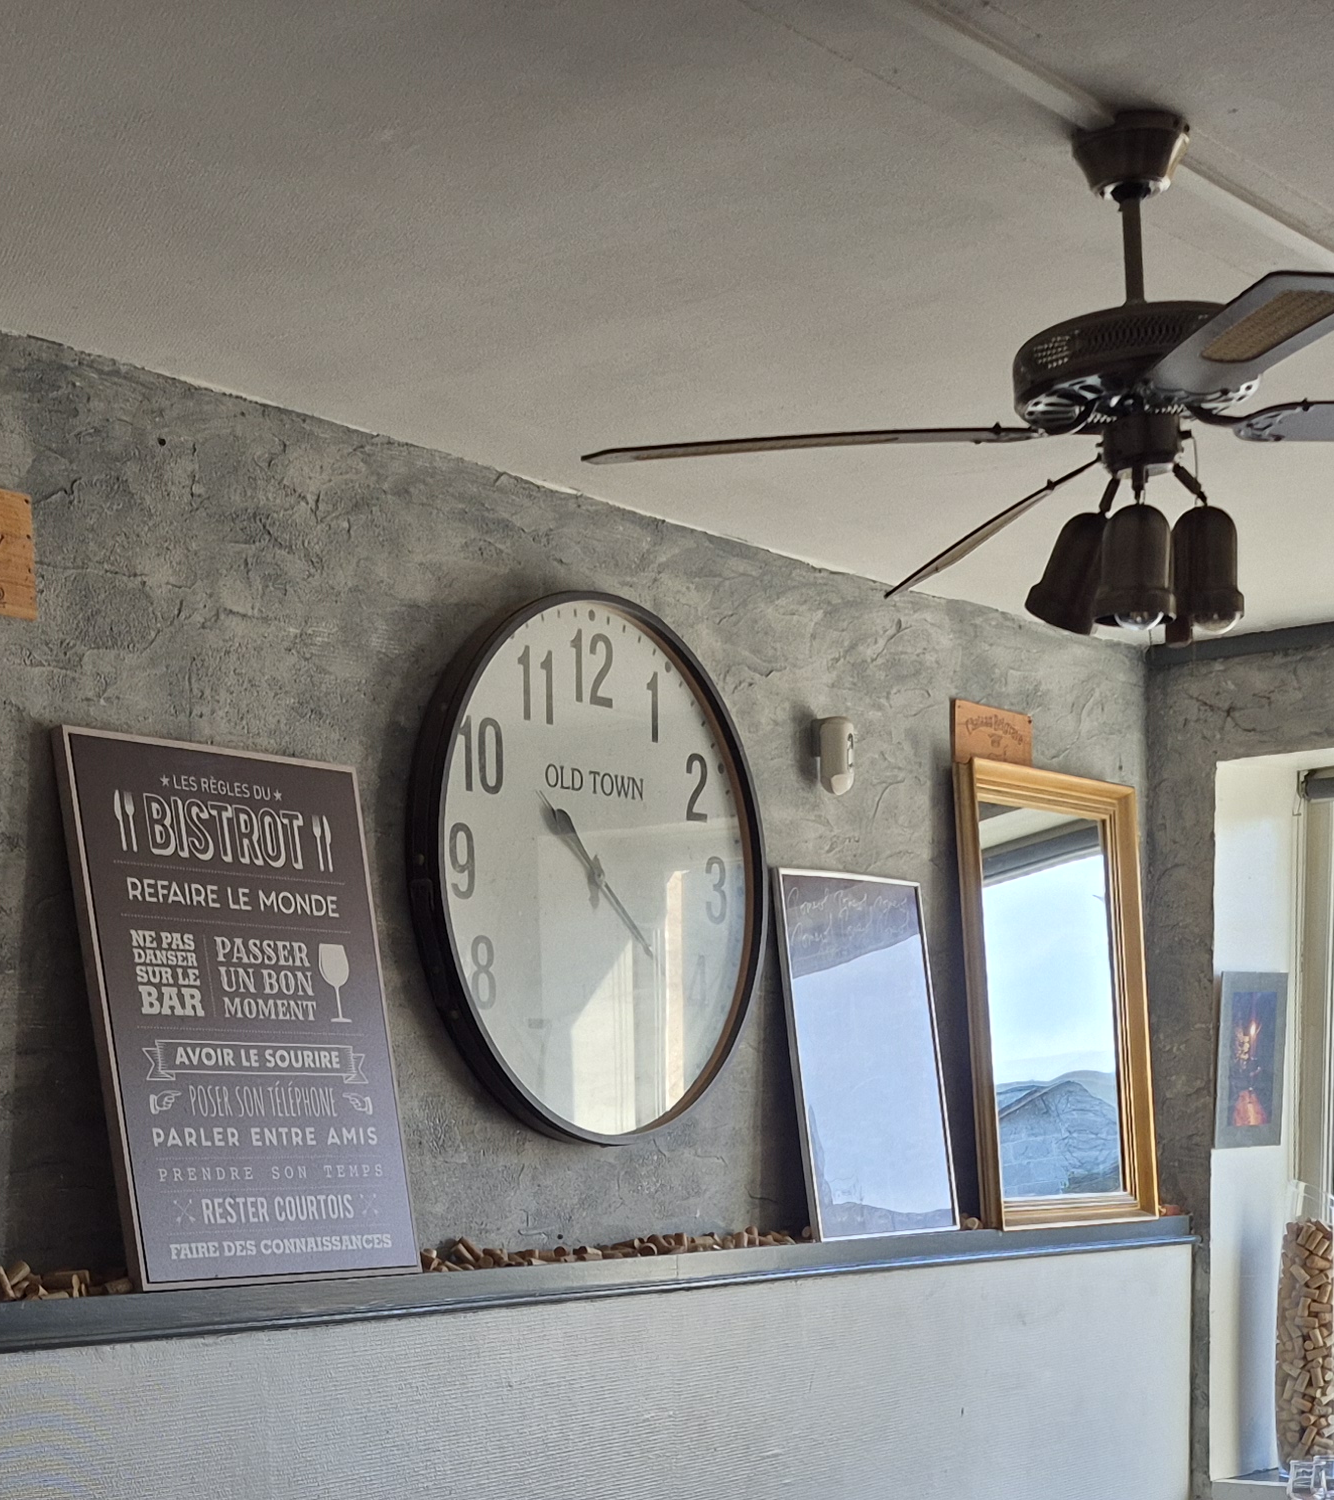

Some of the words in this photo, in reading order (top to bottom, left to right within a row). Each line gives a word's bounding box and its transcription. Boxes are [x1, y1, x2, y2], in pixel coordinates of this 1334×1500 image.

[570, 628, 614, 709] 12
[517, 645, 554, 725] 11
[646, 672, 659, 743] 1
[457, 715, 504, 795] 10
[173, 774, 197, 791] LES
[201, 774, 250, 797] RÈGLES
[253, 785, 271, 801] DU
[545, 763, 584, 793] OLD
[590, 770, 644, 800] TOWN
[685, 753, 708, 823] 2
[143, 793, 304, 870] BISTROT
[448, 822, 475, 900] 9
[127, 877, 220, 909] REFAIRE
[227, 888, 250, 912] LE
[258, 890, 340, 918] MONDE
[705, 856, 727, 925] 3
[130, 929, 157, 948] NE
[160, 932, 195, 950] PAS
[214, 936, 310, 967] PASSER
[133, 948, 197, 967] DANSER
[471, 935, 497, 1011] 8
[136, 966, 174, 984] SUR
[176, 968, 200, 986] LE
[218, 967, 257, 993] UN
[261, 969, 314, 996] BON
[138, 985, 205, 1017] BAR
[223, 997, 316, 1021] MOMENT
[175, 1046, 234, 1067] AVOIR
[241, 1048, 260, 1067] LE
[265, 1048, 341, 1069] SOURIRE
[189, 1085, 232, 1117] POSER
[236, 1086, 265, 1117] SON
[267, 1080, 338, 1118] TÉLÉPHONE
[152, 1127, 240, 1147] PARLER
[252, 1127, 317, 1146] ENTRE
[327, 1127, 378, 1145] AMIS
[158, 1166, 253, 1182] PRENDRE
[271, 1165, 308, 1179] SON
[324, 1163, 384, 1178] TEMPS
[201, 1197, 269, 1224] RESTER
[274, 1194, 355, 1222] COURTOIS
[170, 1242, 220, 1260] FAIRE
[224, 1239, 256, 1256] DES
[260, 1234, 392, 1255] CONNAISSANCES
